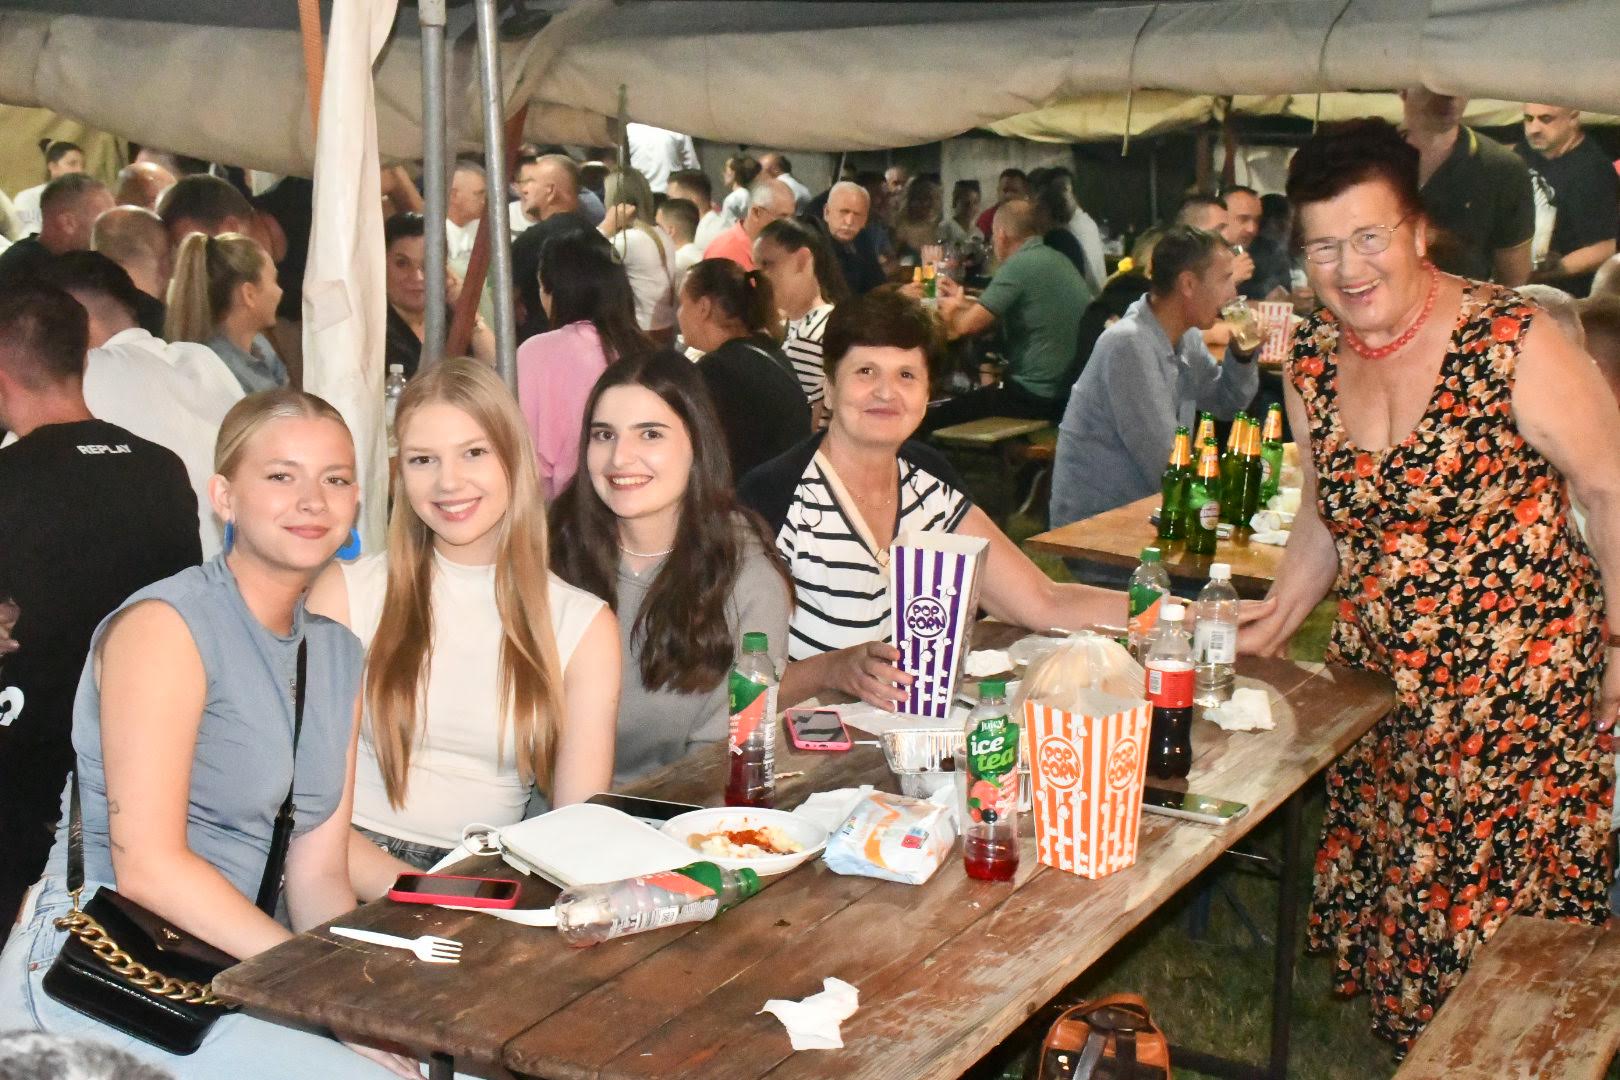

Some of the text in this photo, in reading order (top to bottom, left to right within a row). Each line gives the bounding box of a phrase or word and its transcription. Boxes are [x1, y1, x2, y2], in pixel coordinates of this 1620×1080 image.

[76, 444, 132, 455] REPLAY
[912, 604, 940, 617] POP
[907, 616, 946, 630] CORN
[971, 735, 1005, 756] ice
[1044, 745, 1072, 762] POP
[1112, 745, 1134, 765] POP
[977, 747, 1014, 771] tea
[1041, 760, 1080, 779] CORN
[1108, 760, 1137, 784] CORN
